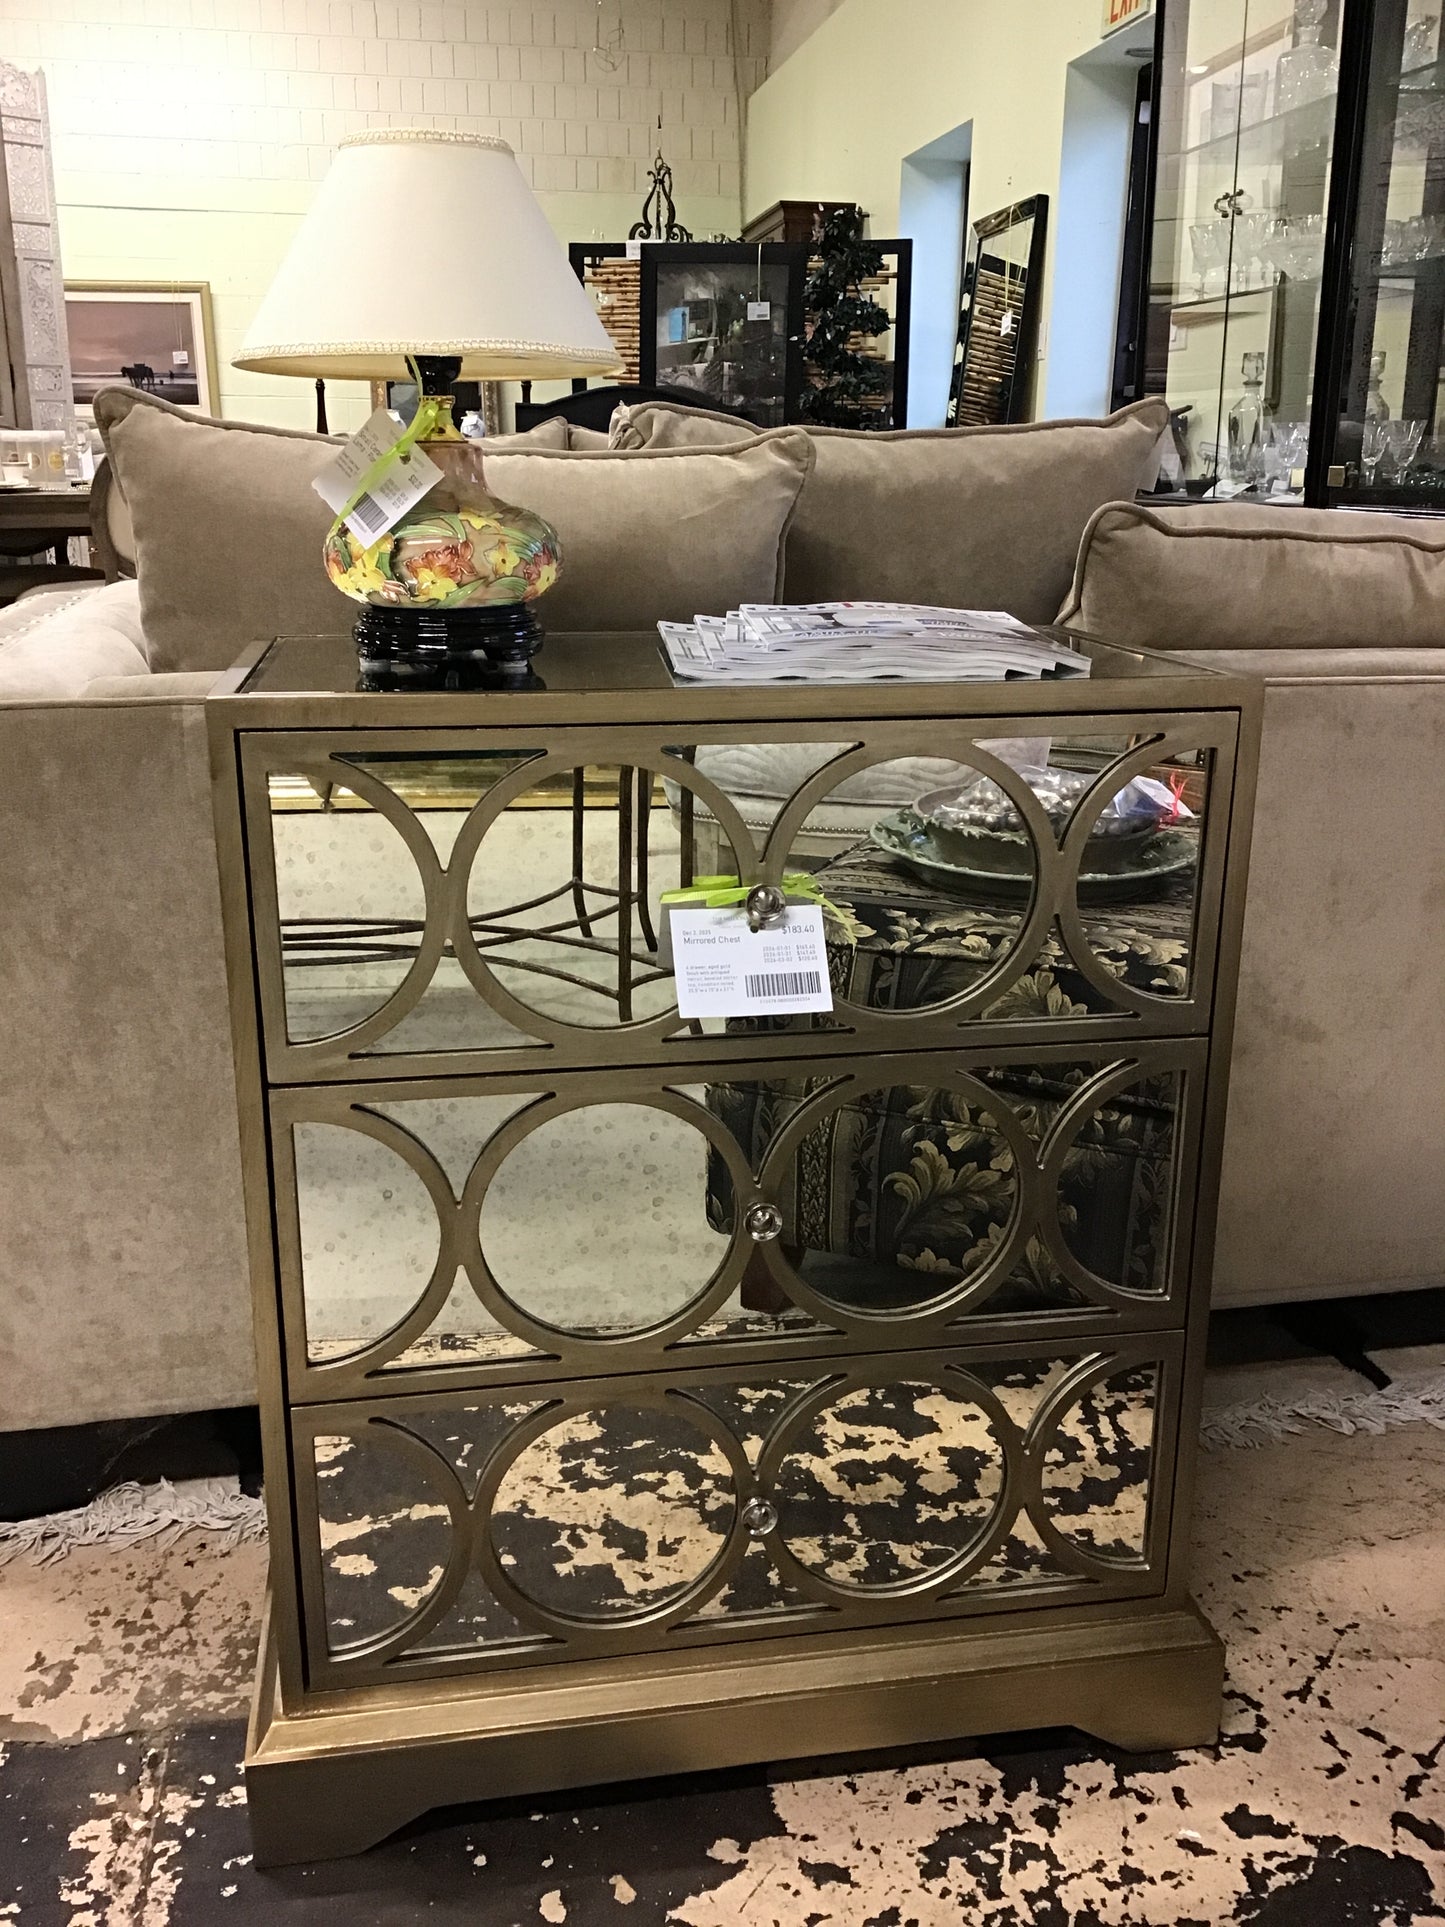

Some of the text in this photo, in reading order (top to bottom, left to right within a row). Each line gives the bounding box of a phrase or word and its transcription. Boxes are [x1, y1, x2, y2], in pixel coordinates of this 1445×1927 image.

[782, 924, 815, 935] $183.40
[683, 936, 741, 945] Mirrored Chest
